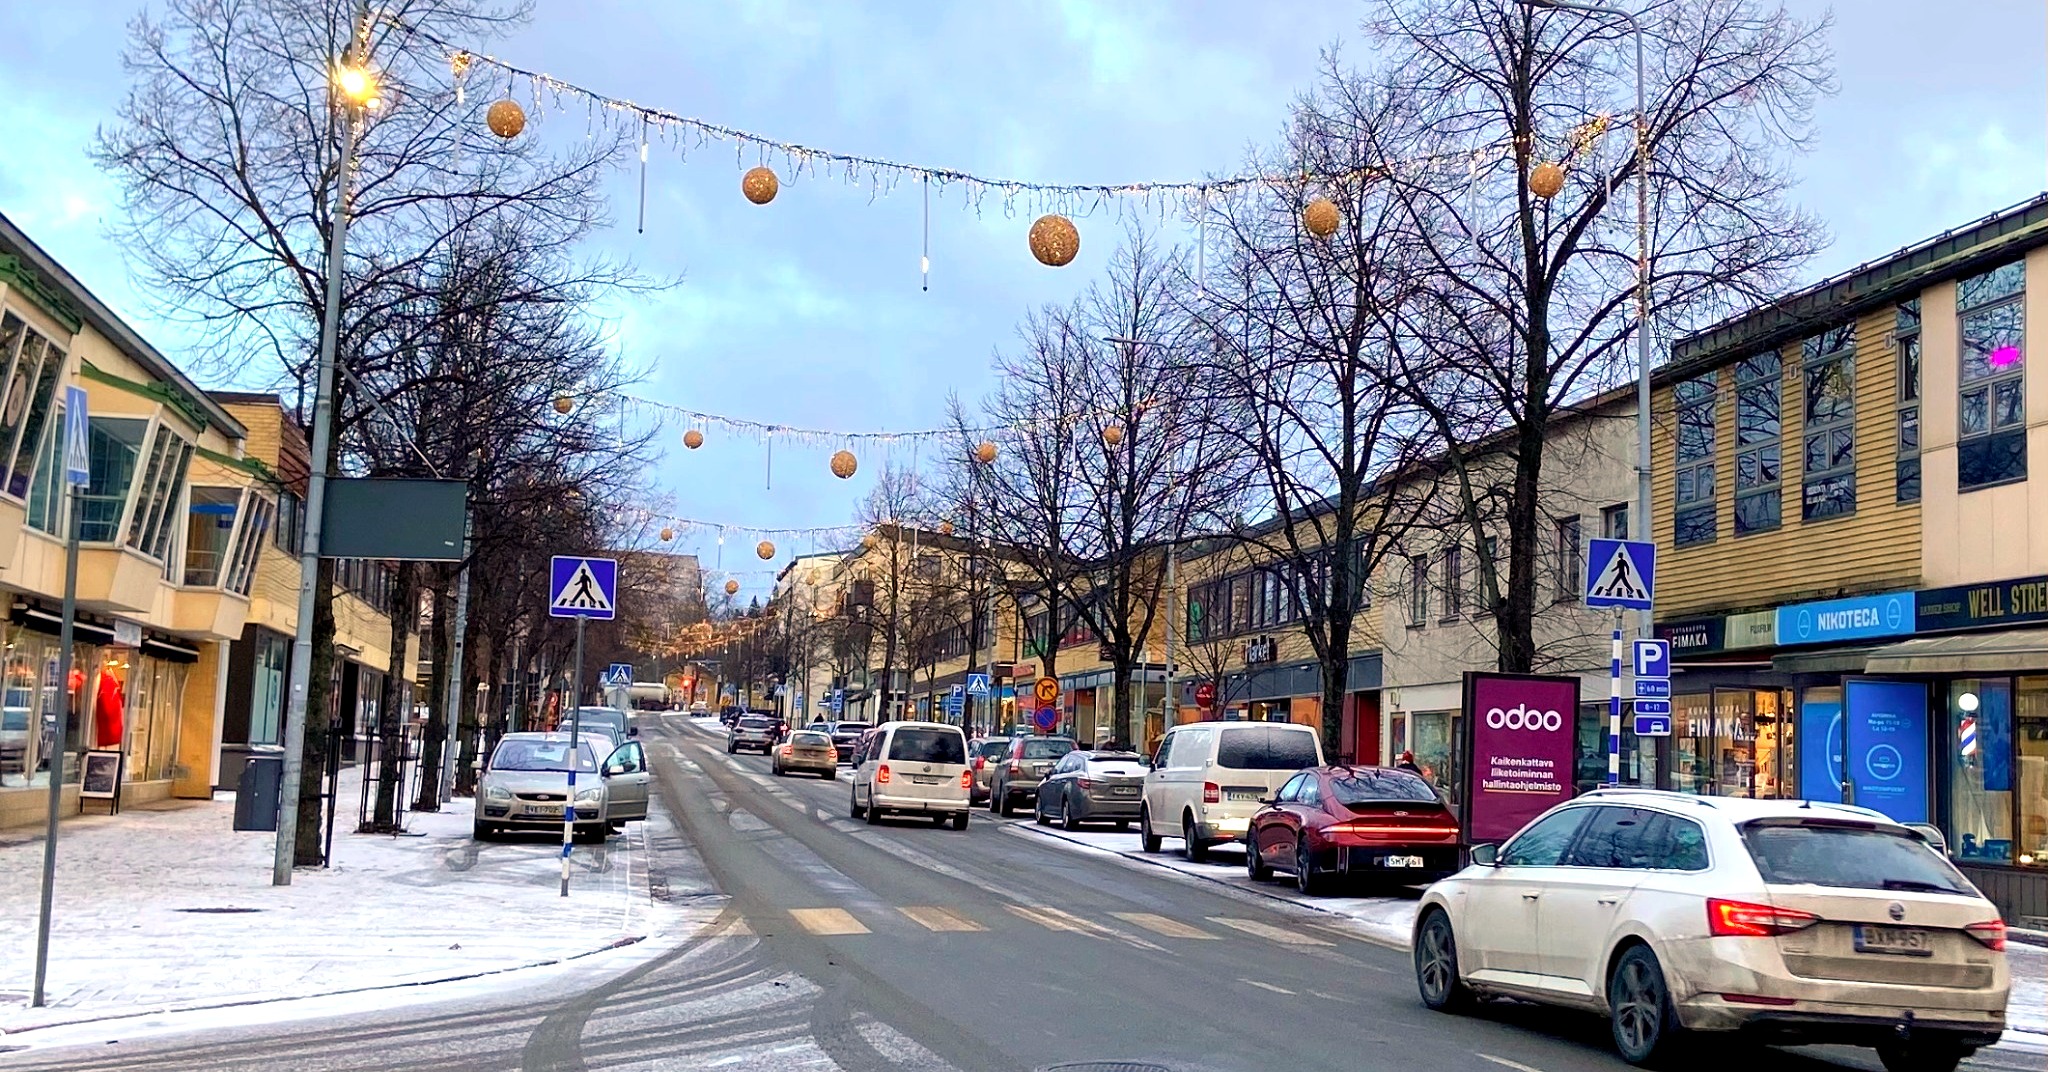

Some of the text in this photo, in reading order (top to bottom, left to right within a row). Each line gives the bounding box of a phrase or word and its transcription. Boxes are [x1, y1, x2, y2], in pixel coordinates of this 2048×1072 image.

[1968, 587, 2004, 618] WELL
[2011, 582, 2048, 614] STRE
[1818, 607, 1880, 631] NIKOTECA
[1672, 632, 1708, 648] FIMAKA
[1640, 643, 1663, 675] P
[1486, 703, 1562, 732] odoo
[1490, 756, 1554, 768] Kaikenkattava
[1490, 768, 1554, 779] liiketoiminnan
[1482, 779, 1562, 791] hallintaohjelmisto
